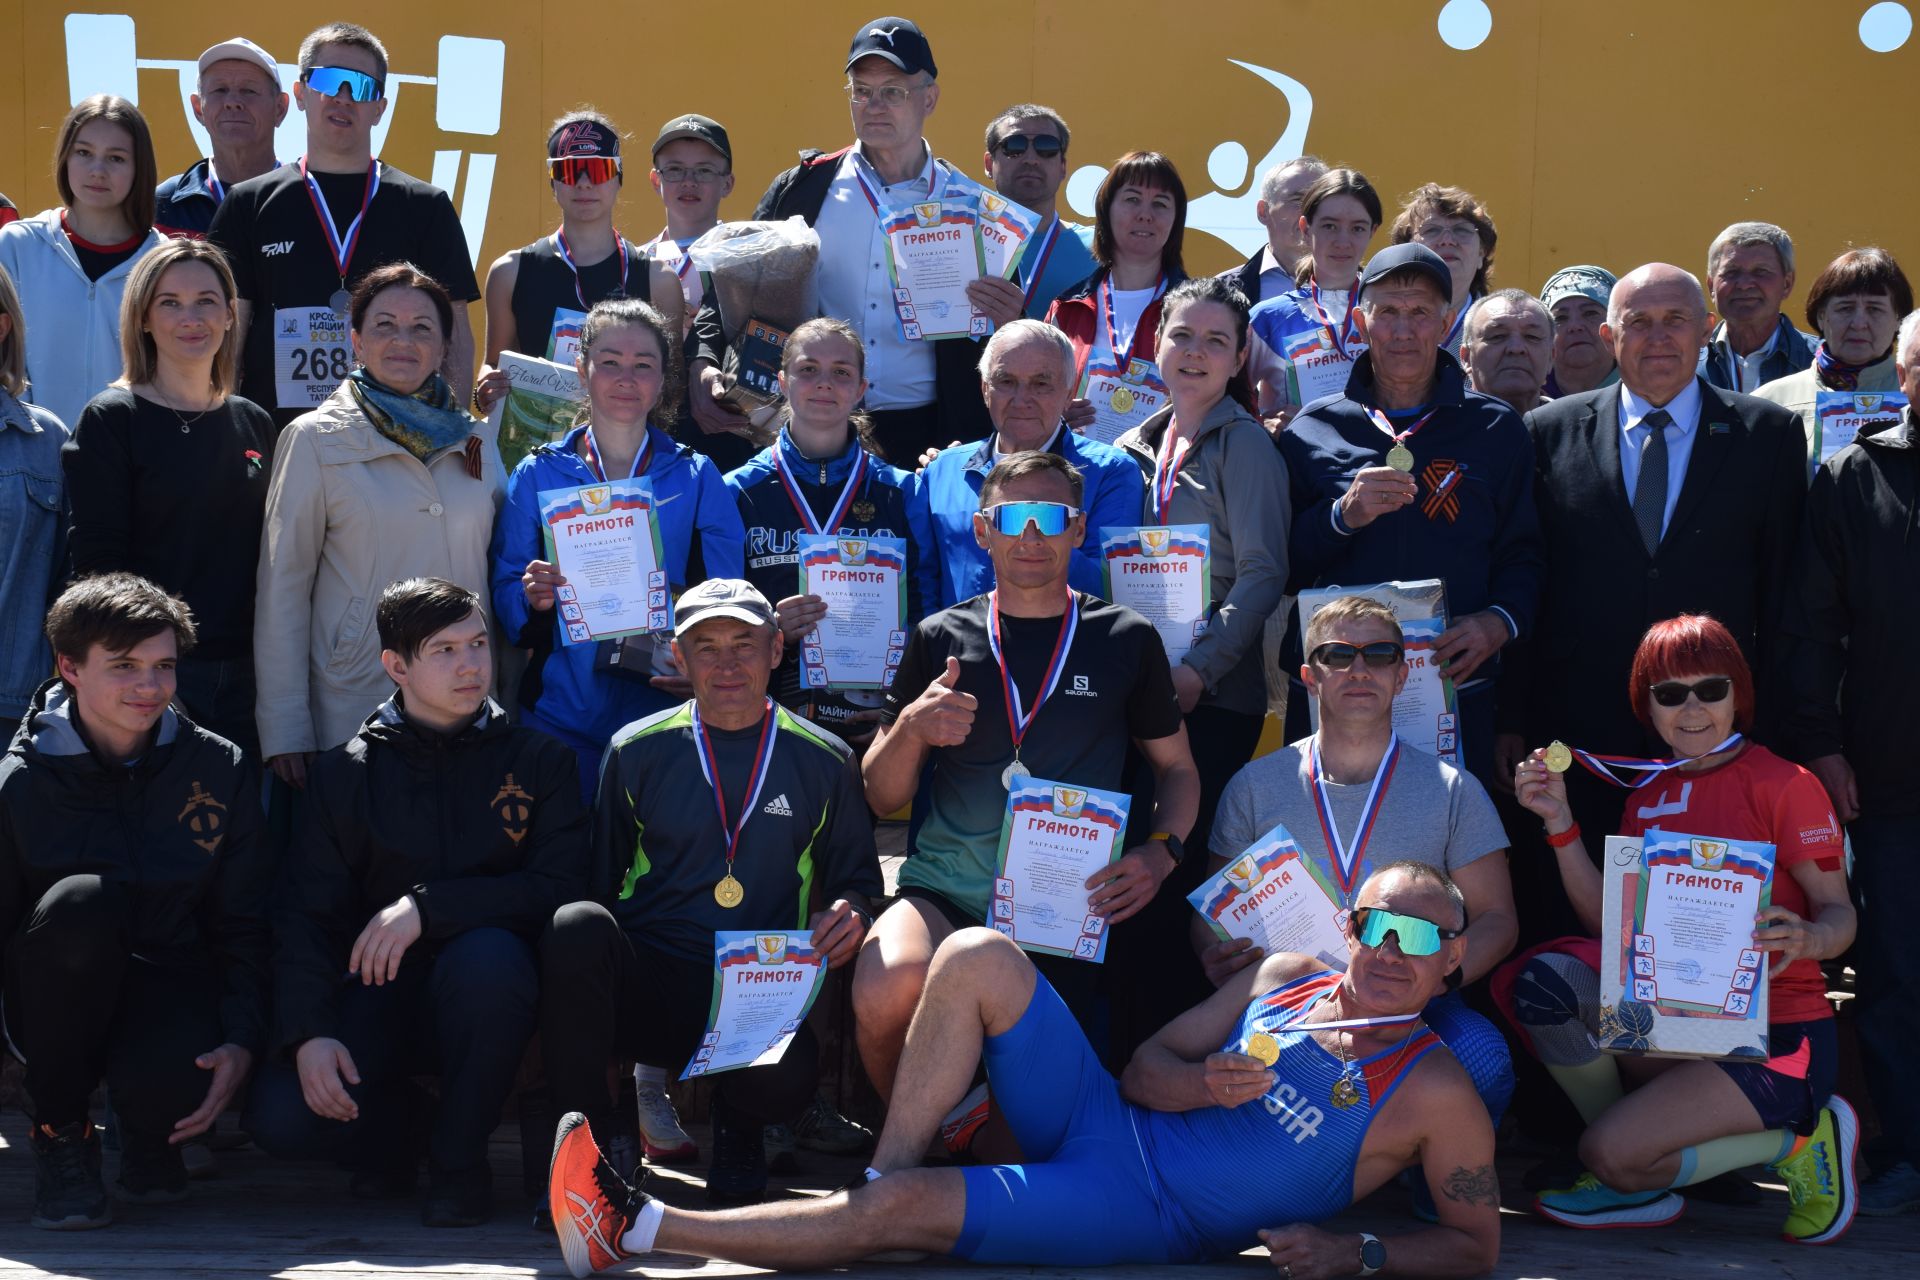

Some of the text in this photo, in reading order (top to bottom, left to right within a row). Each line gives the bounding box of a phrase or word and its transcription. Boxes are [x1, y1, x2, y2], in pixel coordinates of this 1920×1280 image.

[903, 229, 961, 246] ГРАМОТА
[309, 322, 345, 332] НАЦИИ
[310, 331, 346, 343] 2023
[508, 364, 546, 385] Floral
[306, 385, 341, 393] РЕСПУБ
[567, 515, 635, 536] ГРАМОТА
[574, 536, 632, 549] НАГРАЖДАЕТСЯ
[755, 554, 800, 567] RUSSI
[1122, 561, 1189, 575] ГРАМОТА
[821, 569, 885, 583] ГРАМОТА
[818, 703, 857, 719] ЧАЙНИ
[764, 806, 793, 817] adidas
[1027, 817, 1099, 841] ГРАМОТА
[1028, 839, 1090, 855] НАГРАЖДАЕТСЯ
[1665, 872, 1744, 894] ГРАМОТА
[1231, 870, 1294, 923] ГРАМОТА
[1668, 895, 1735, 908] НАГРАЖДАЕТСЯ
[1248, 891, 1300, 932] НАГРАЖДАЕТСЯ
[737, 970, 803, 984] ГРАМОТА
[1264, 1069, 1324, 1144] SIA
